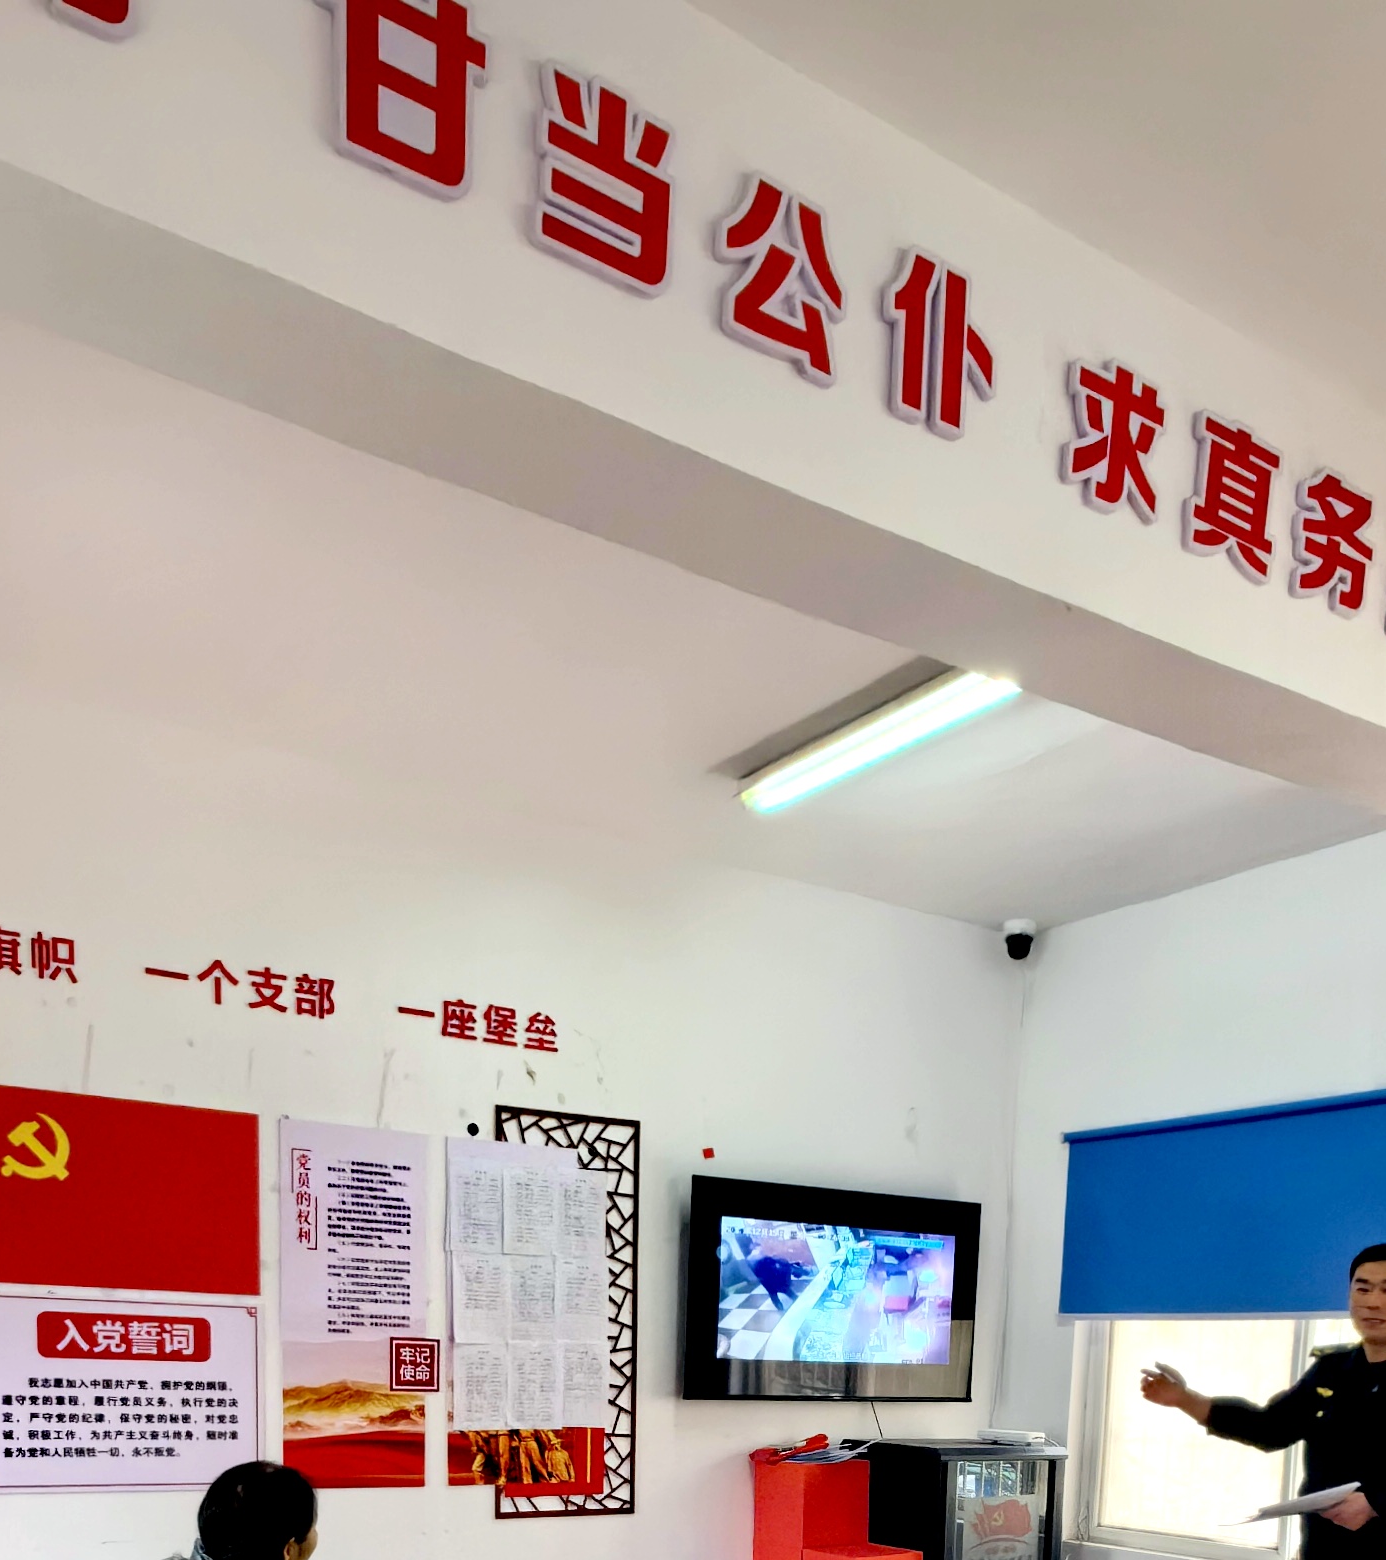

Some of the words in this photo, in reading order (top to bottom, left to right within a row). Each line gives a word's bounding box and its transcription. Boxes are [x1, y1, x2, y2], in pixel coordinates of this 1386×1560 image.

[345, 0, 995, 430] 甘当公仆
[144, 959, 335, 1019] 一个支部
[397, 999, 559, 1052] 一座堡垒
[296, 1153, 312, 1245] 党员的权利
[56, 1318, 195, 1356] 入党誓词
[399, 1347, 431, 1364] 牢记
[399, 1364, 431, 1382] 使命
